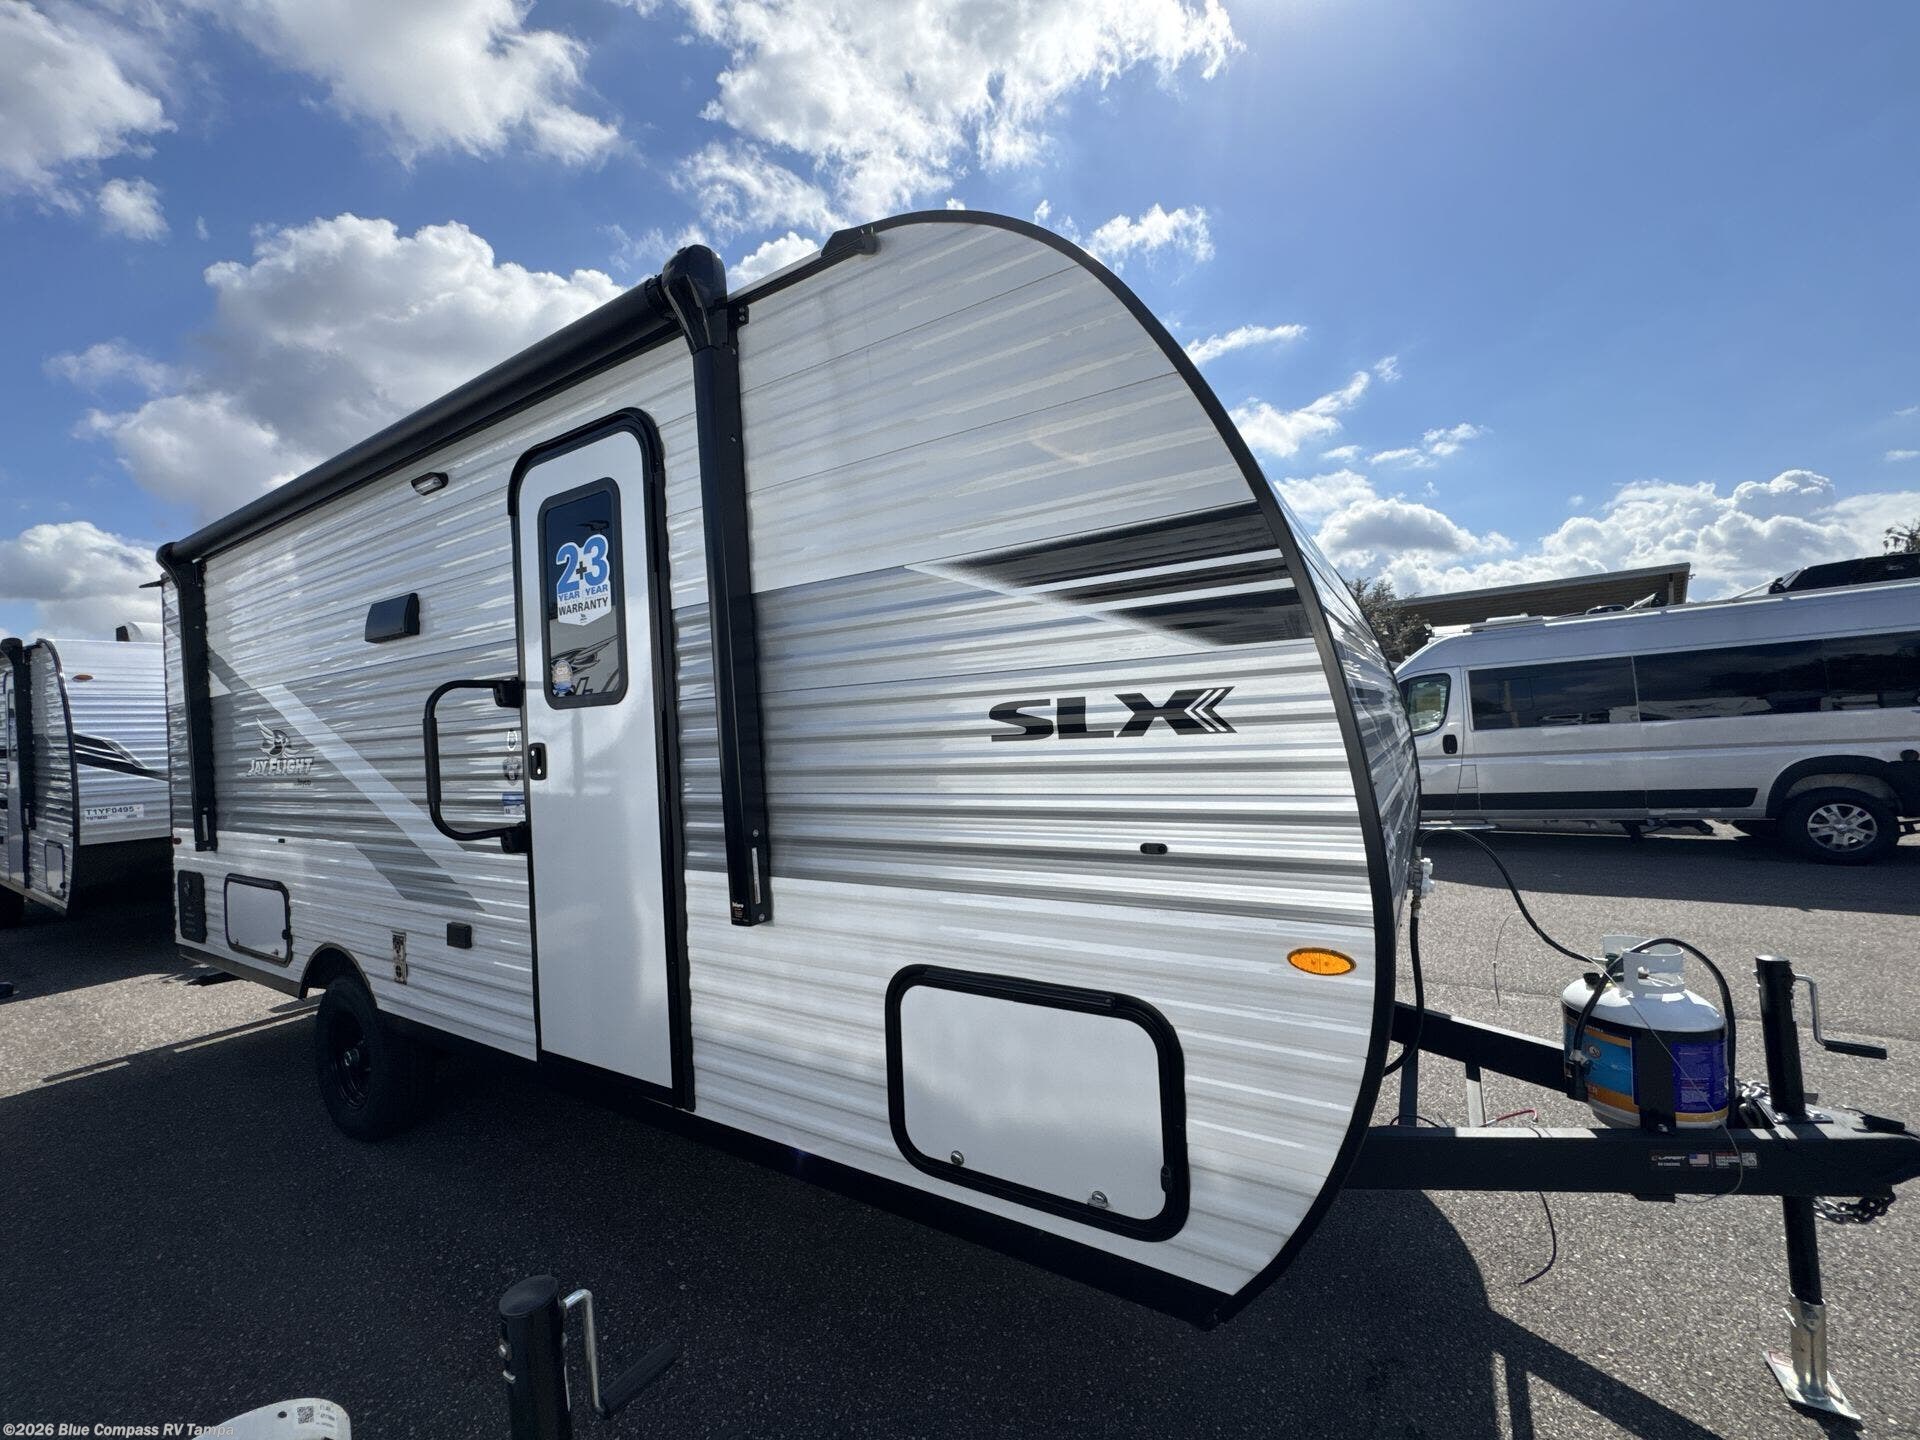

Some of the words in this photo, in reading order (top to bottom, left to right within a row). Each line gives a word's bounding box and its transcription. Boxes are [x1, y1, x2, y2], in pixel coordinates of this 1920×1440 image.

[558, 590, 580, 602] YEAR
[585, 584, 608, 596] YEAR
[558, 597, 608, 616] WARRANTY
[988, 685, 1238, 742] SLX
[246, 759, 268, 777] JAY
[268, 757, 314, 776] FLIGHT
